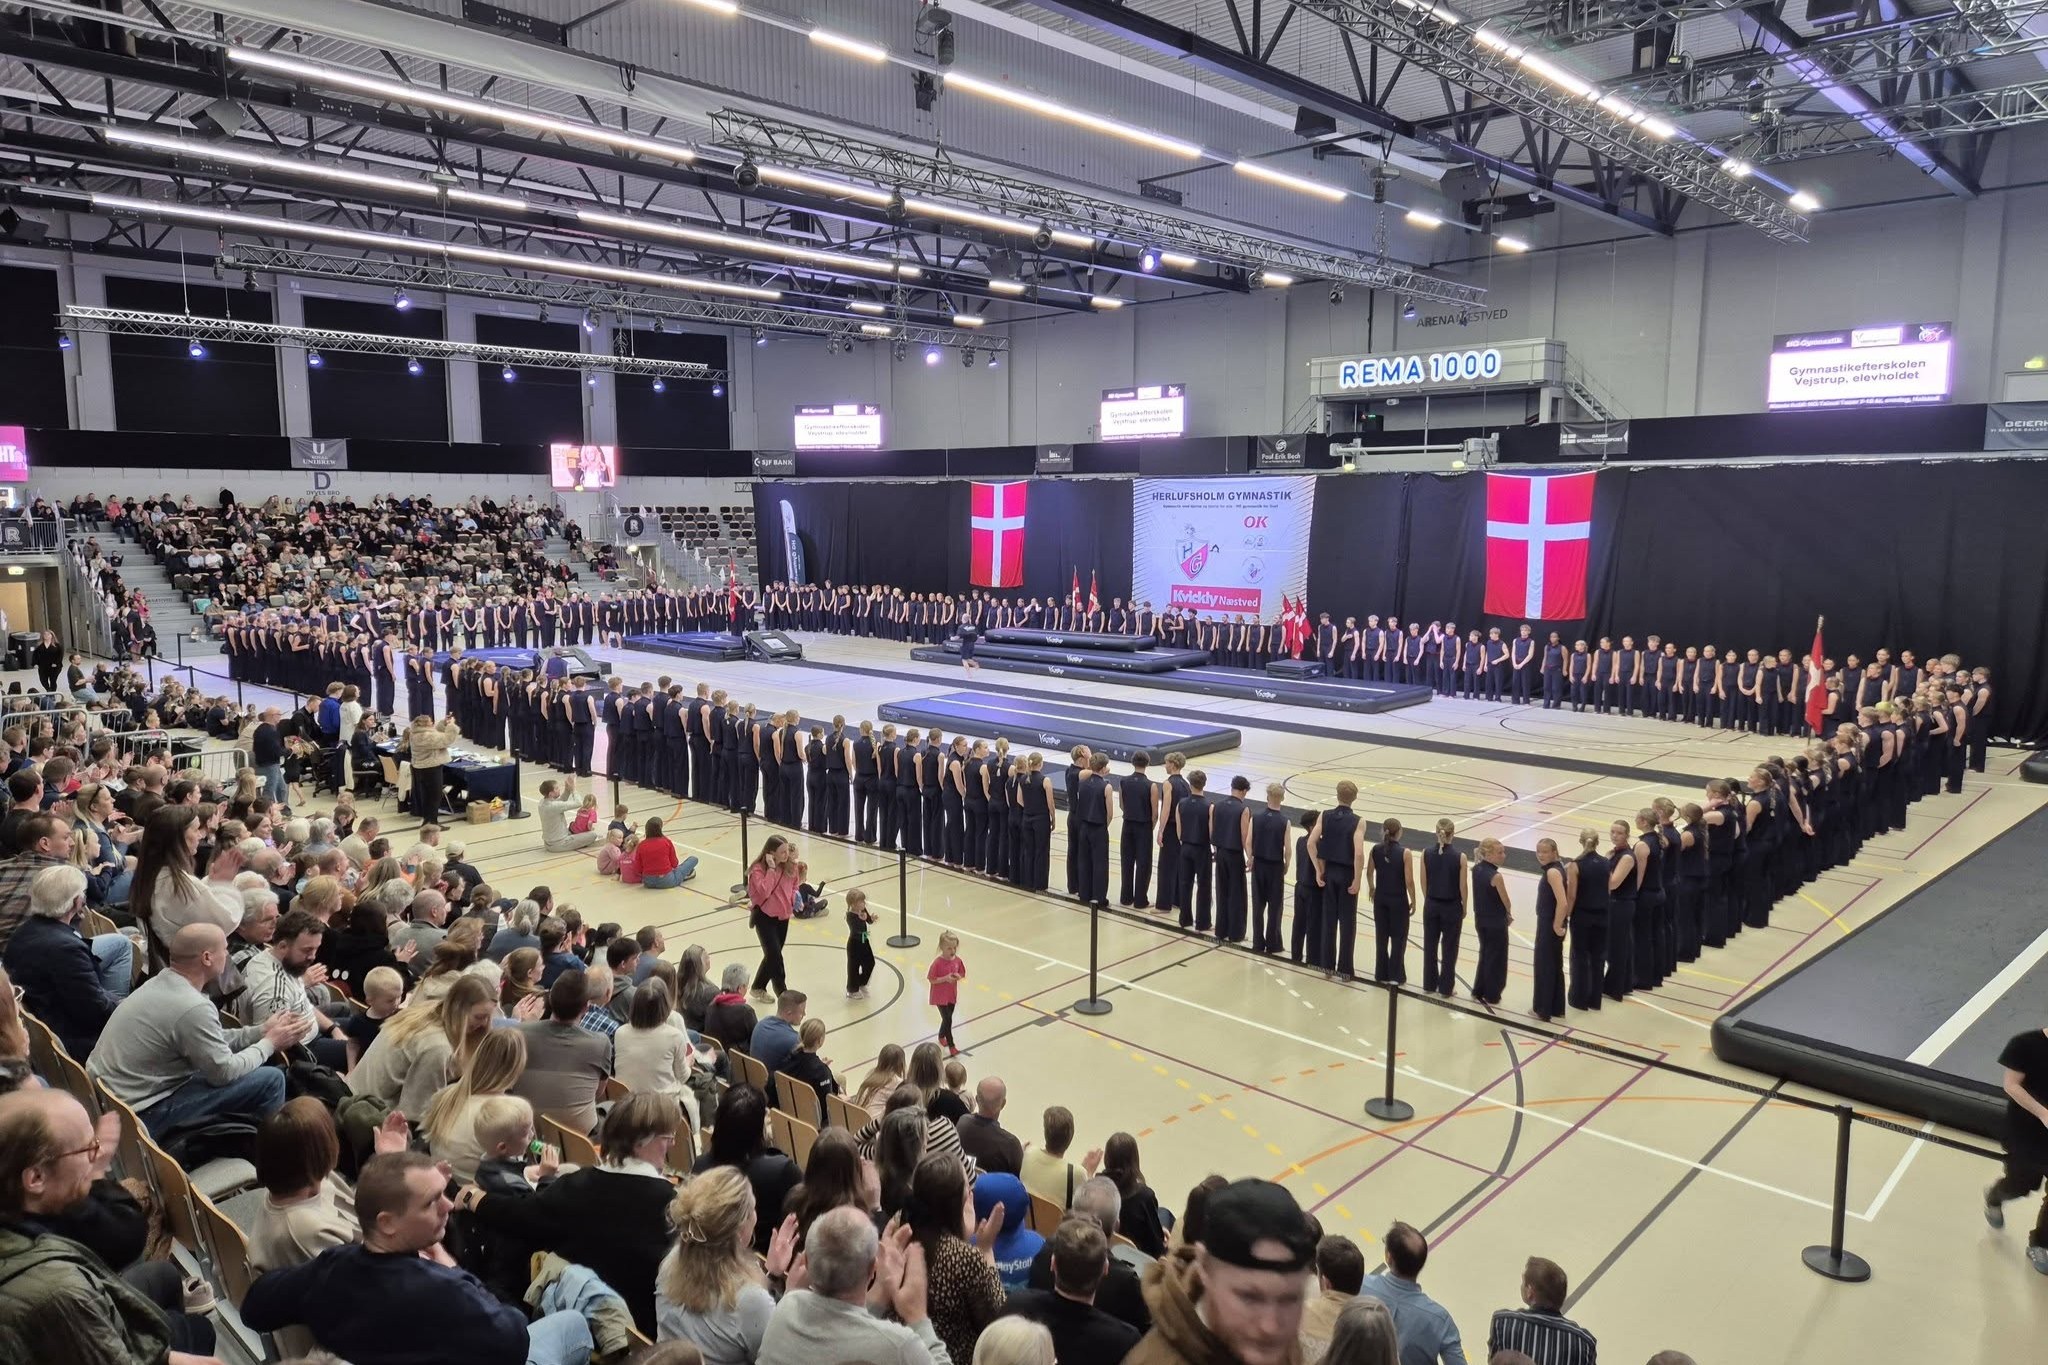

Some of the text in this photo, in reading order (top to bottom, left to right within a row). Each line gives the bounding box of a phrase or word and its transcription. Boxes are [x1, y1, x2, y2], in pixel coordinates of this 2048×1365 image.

[1416, 314, 1455, 328] ARENA
[1341, 350, 1499, 387] REMA 1000
[1789, 360, 1926, 377] Gymnastikefterskolen
[1853, 371, 1919, 383] elevholdet
[314, 472, 330, 490] D
[1152, 490, 1292, 501] HERLUFSHOLM GYMNASTIK
[1243, 515, 1269, 528] OK
[1173, 589, 1259, 607] Kvickly Næstved
